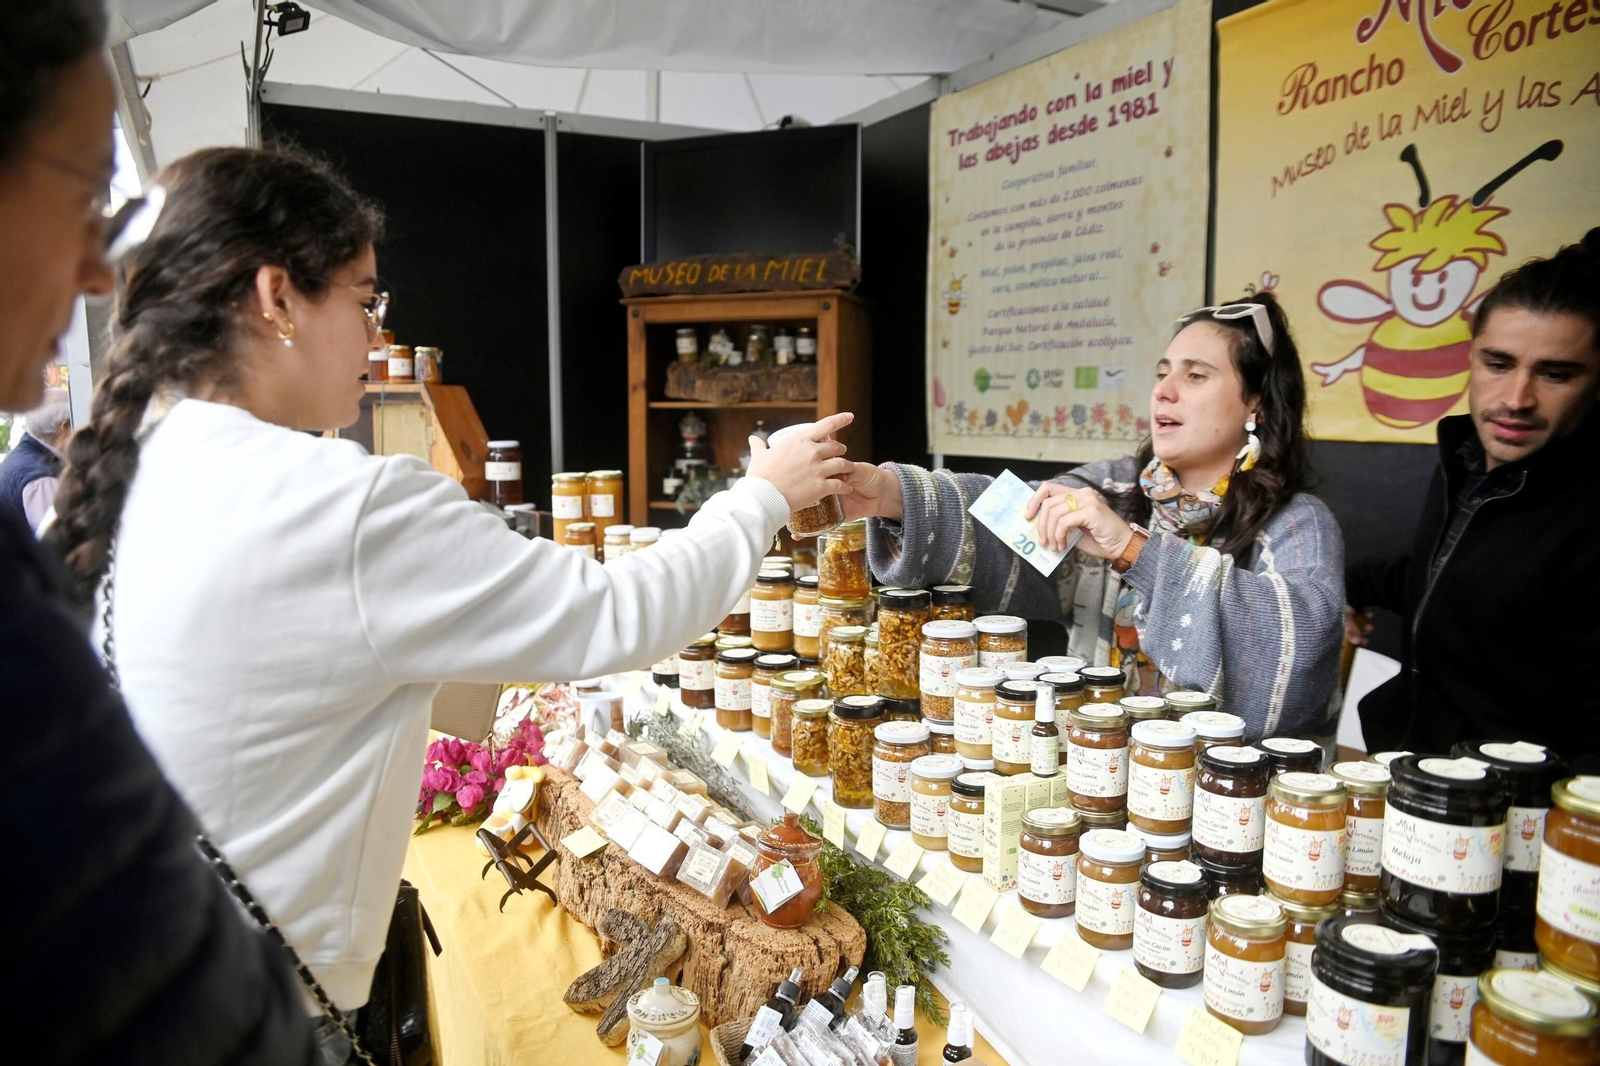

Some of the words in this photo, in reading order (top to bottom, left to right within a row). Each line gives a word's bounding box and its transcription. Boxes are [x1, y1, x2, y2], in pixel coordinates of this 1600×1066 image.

[1276, 53, 1405, 116] Rancho
[948, 103, 1038, 147] Trabajando
[1046, 92, 1077, 115] con
[1085, 81, 1103, 103] la
[1111, 60, 1154, 94] miel
[1163, 57, 1175, 88] y
[958, 152, 978, 171] las
[985, 135, 1040, 165] abejas
[1048, 114, 1099, 145] desde
[1107, 91, 1159, 127] 1981
[1272, 143, 1336, 197] Museo
[1344, 120, 1371, 156] de
[1378, 112, 1403, 142] la
[1412, 87, 1472, 132] Miel
[1480, 89, 1504, 132] y
[1516, 75, 1563, 110] las
[1002, 169, 1055, 191] Cooperativa
[967, 207, 1008, 222] Contamos
[1010, 203, 1026, 214] con
[1095, 174, 1144, 195] colmenas
[1086, 199, 1125, 218] montes
[1018, 231, 1059, 250] provincia
[629, 261, 701, 288] MUSEO
[707, 264, 730, 283] DE
[734, 263, 757, 281] LA
[763, 258, 828, 284] MIEL
[988, 304, 1050, 320] Certificaciones
[1015, 321, 1050, 335] Natural
[1011, 533, 1036, 556] 20
[1396, 818, 1416, 838] Miel
[1391, 845, 1422, 865] Meloja
[1151, 942, 1171, 952] Cacao
[1211, 953, 1228, 972] Miel
[1223, 986, 1246, 998] Limón
